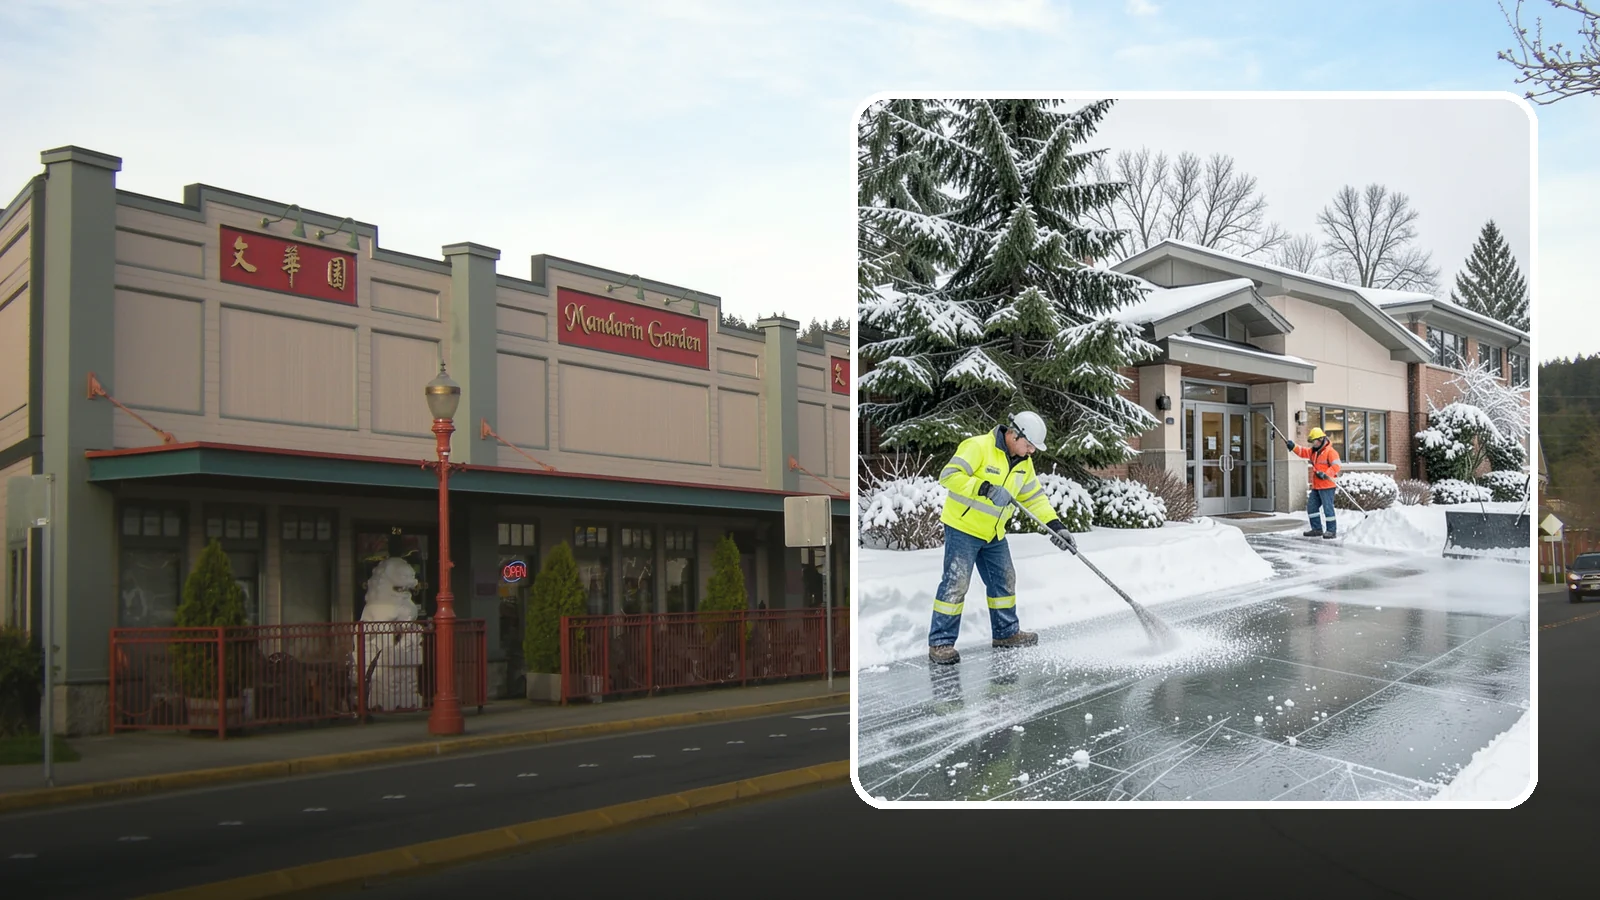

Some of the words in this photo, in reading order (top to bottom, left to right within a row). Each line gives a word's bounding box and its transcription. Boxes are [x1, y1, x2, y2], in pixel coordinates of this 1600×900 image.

[231, 235, 346, 291] 文華園
[564, 302, 644, 341] Mandarin
[648, 320, 702, 353] Garden
[834, 362, 847, 387] 文
[503, 565, 527, 578] OPEN
